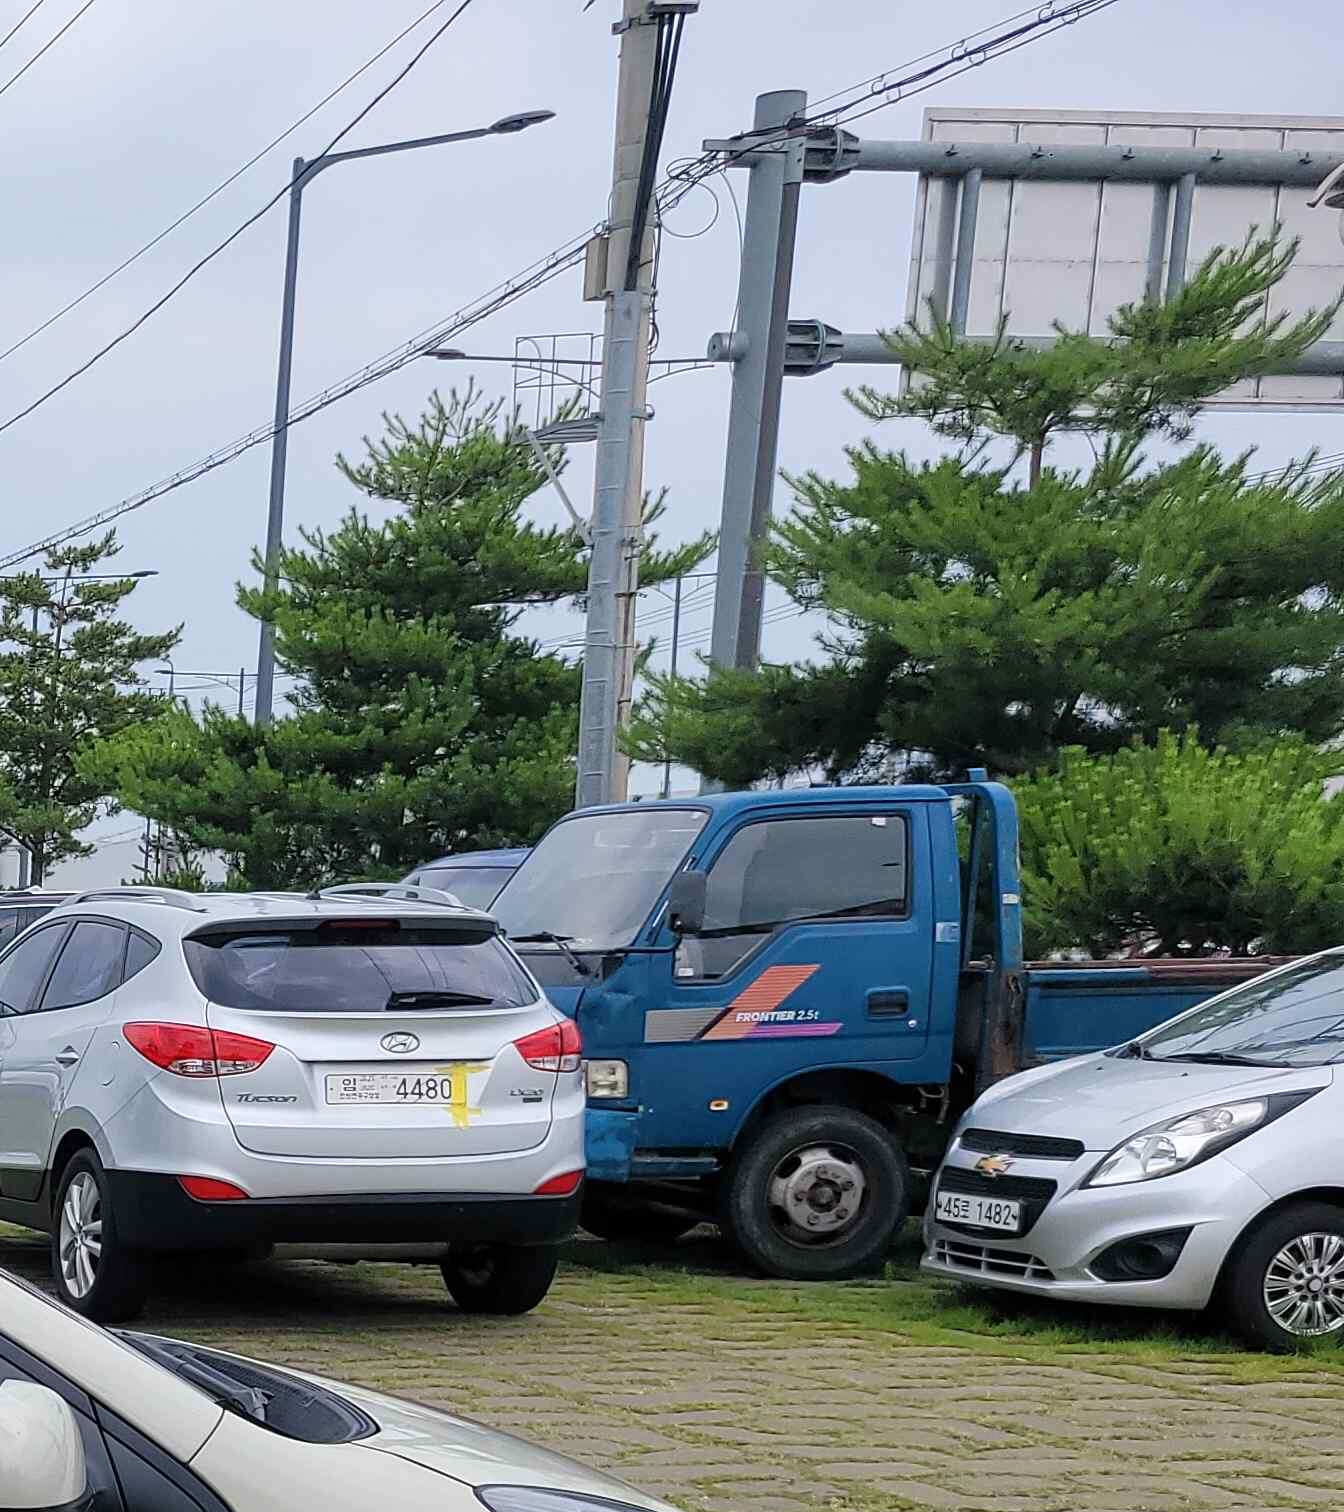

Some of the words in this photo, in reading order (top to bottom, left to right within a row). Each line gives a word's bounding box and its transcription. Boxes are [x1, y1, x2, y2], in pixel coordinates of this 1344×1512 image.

[735, 1010, 796, 1022] FRONTIER
[797, 1009, 820, 1020] 2.5t
[395, 1078, 453, 1100] 4480
[977, 1200, 1012, 1225] 1482
